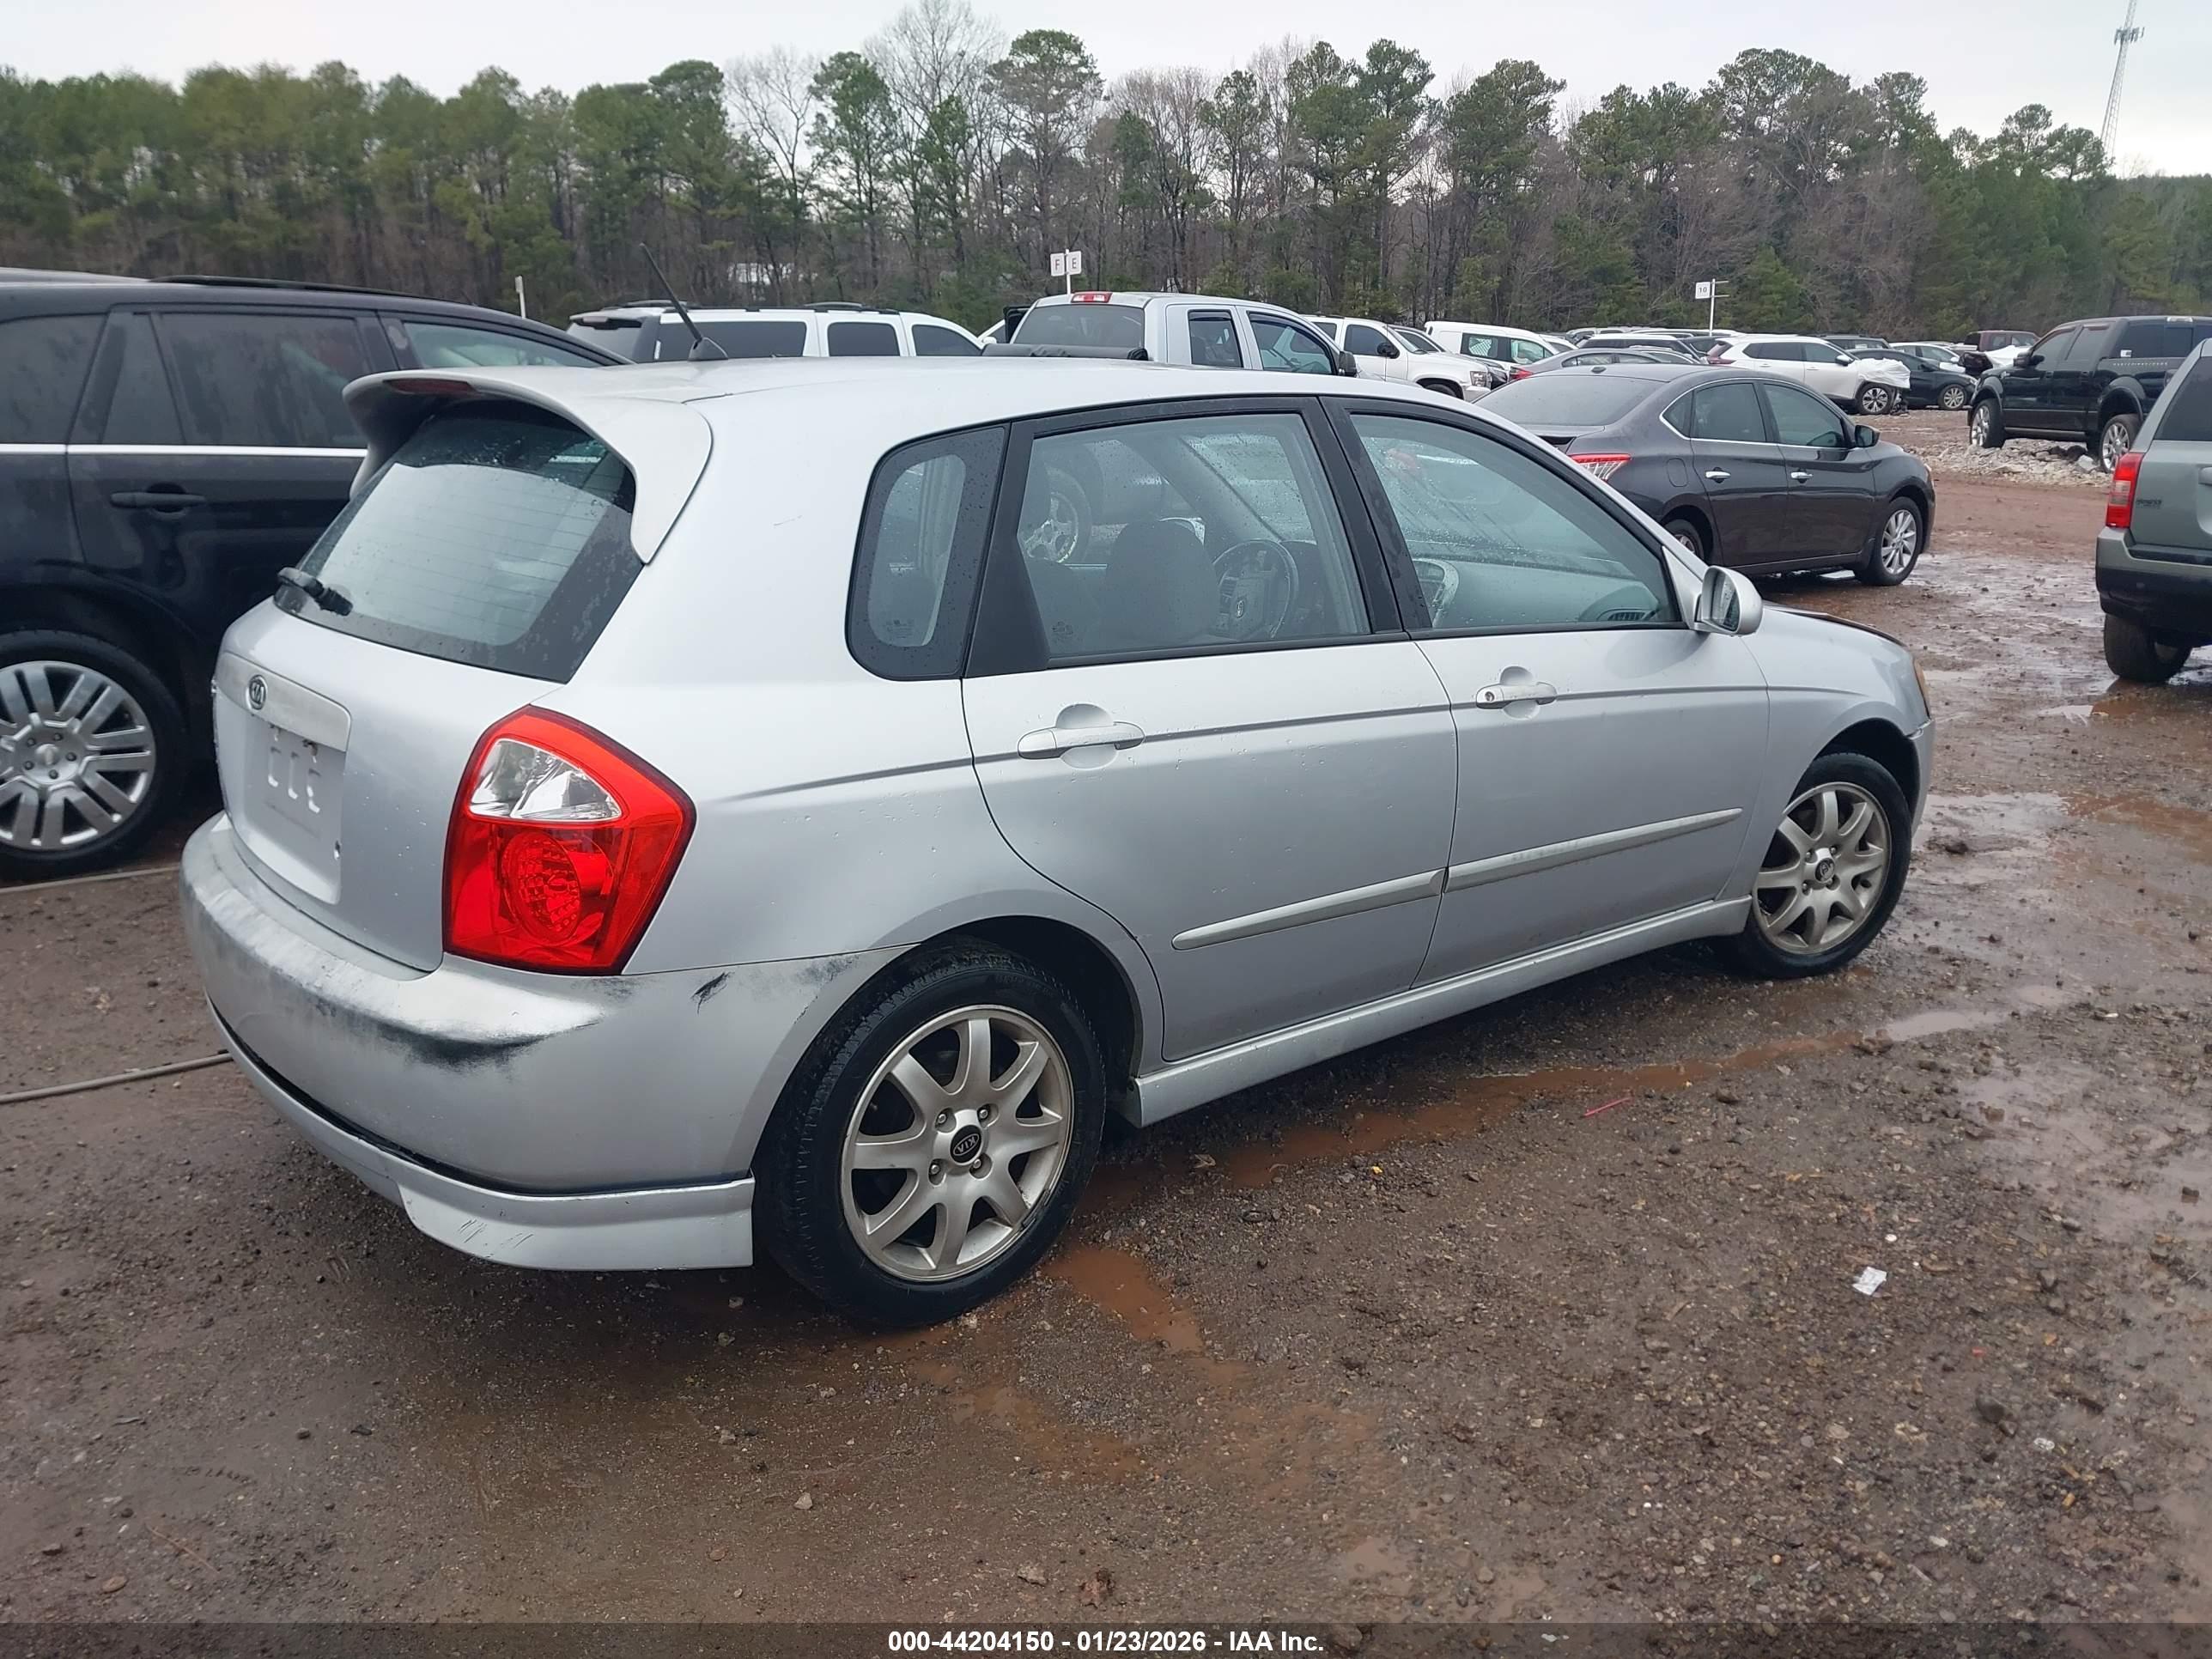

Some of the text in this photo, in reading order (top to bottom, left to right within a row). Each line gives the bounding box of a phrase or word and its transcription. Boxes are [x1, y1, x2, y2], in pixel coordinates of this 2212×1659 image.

[1054, 258, 1060, 270] F
[1072, 258, 1077, 269] E
[955, 1135, 978, 1154] KIA
